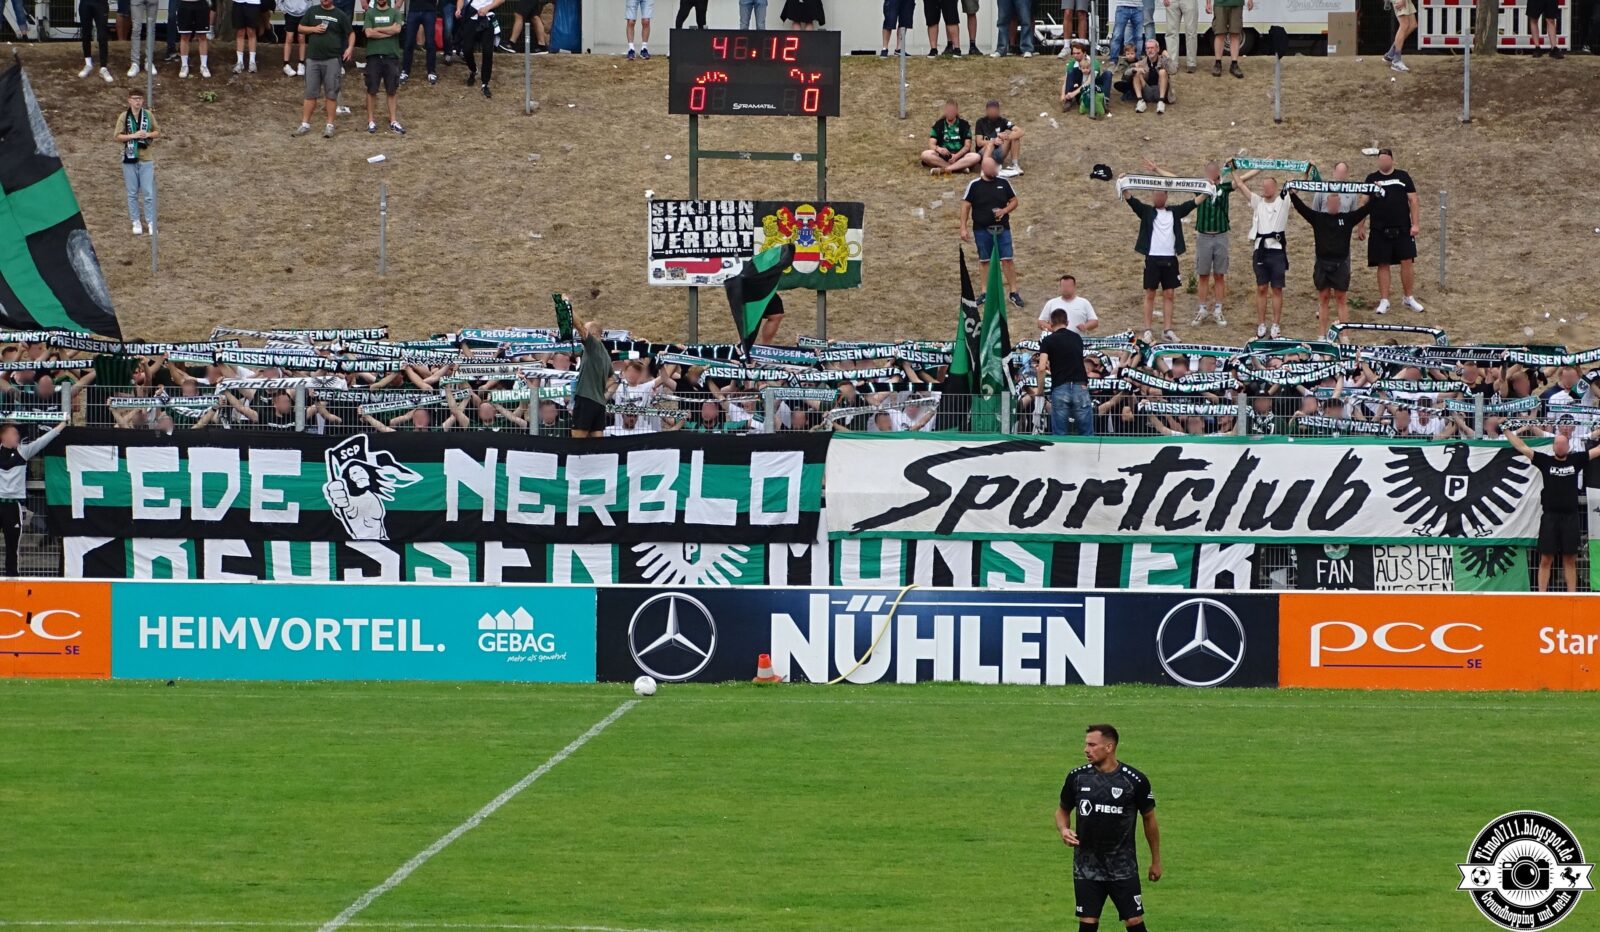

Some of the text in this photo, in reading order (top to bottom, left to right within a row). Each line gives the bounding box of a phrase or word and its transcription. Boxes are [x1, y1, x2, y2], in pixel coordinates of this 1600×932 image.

[689, 86, 820, 112] 0 0
[732, 102, 777, 110] STRAMATEL
[1128, 177, 1162, 187] PREUSSEN
[652, 199, 754, 216] SEKTION
[652, 214, 754, 233] STADION
[652, 231, 754, 250] VERBOT
[481, 330, 528, 339] PREUSSEN
[50, 335, 108, 352] PREUSSEN
[344, 341, 400, 357] PREUSSEN
[215, 350, 273, 366] PREUSSEN
[1503, 350, 1561, 366] PREUSSEN
[1120, 367, 1177, 391] PREUSSEN
[314, 390, 371, 402] PREUSSEN
[1137, 401, 1195, 414] PREUSSEN
[340, 444, 361, 460] SCP
[66, 444, 302, 524] FEDE
[443, 447, 805, 527] NERBLO
[849, 438, 1372, 536] Sportclub
[1316, 560, 1354, 584] FAN
[1376, 557, 1454, 582] AUS DEM
[138, 615, 446, 654] HEIMVORTEIL.
[478, 632, 555, 653] GEBAG
[771, 593, 1106, 687] NÜHLEN
[1539, 626, 1599, 655] Star
[65, 645, 80, 655] SE
[1467, 659, 1483, 669] SE
[1094, 804, 1123, 814] FIEGE
